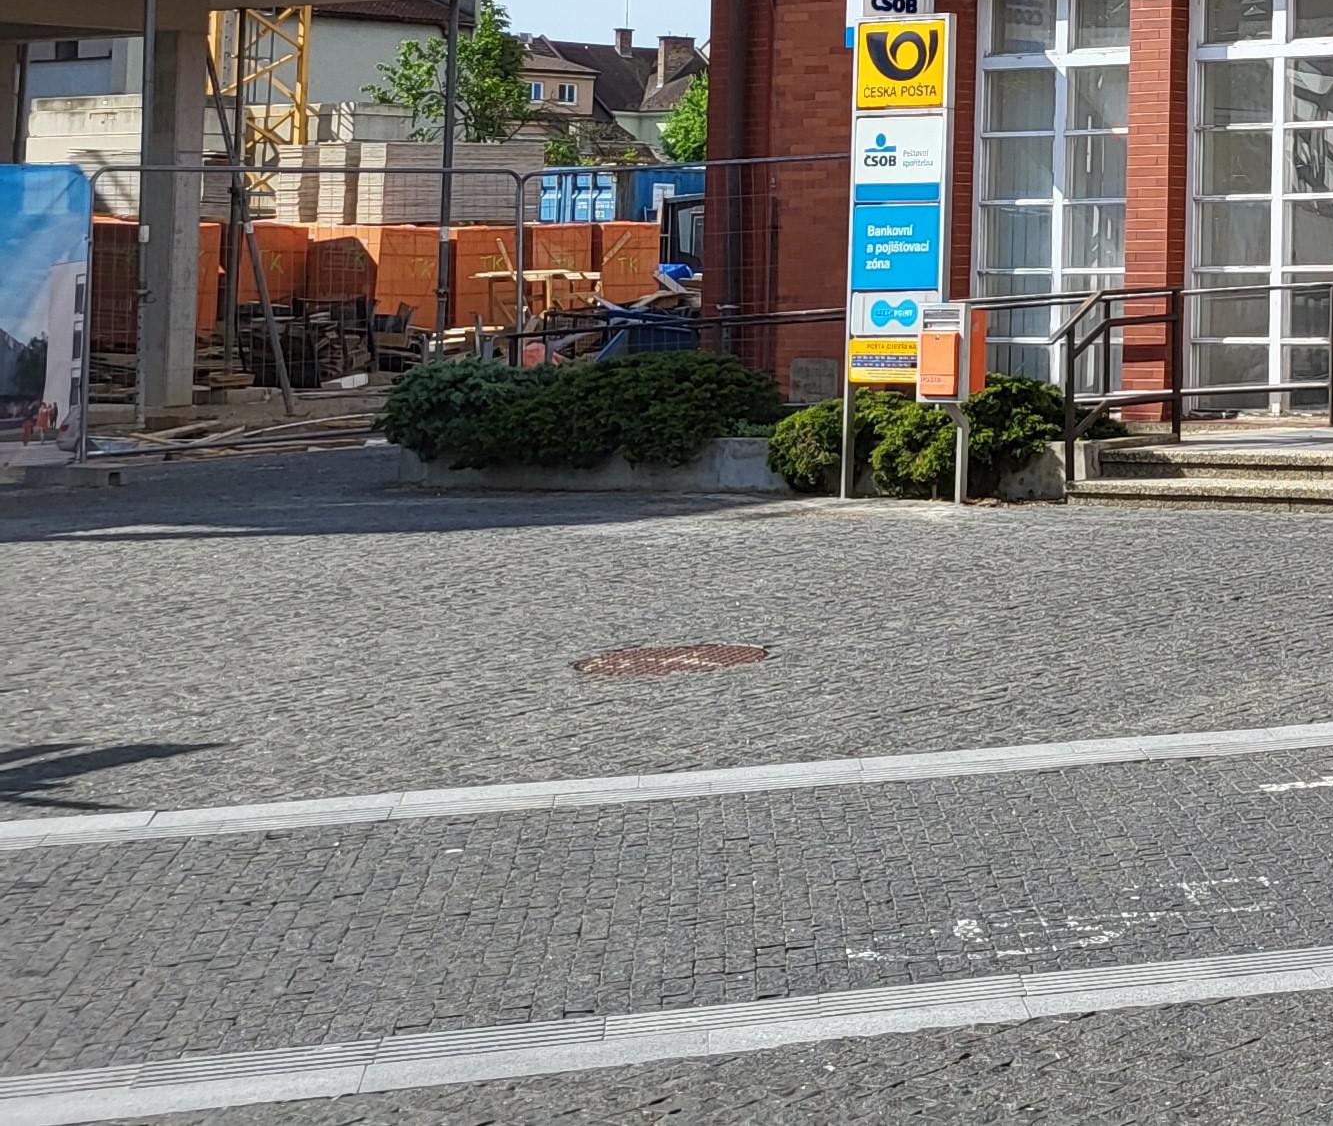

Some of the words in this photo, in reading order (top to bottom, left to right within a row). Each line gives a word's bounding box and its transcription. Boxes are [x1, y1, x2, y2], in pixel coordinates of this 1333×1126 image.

[864, 82, 897, 100] ČESKÁ
[900, 81, 937, 98] POŠTA
[864, 154, 897, 167] ČSOB
[867, 224, 913, 237] Bankovní
[866, 243, 873, 252] a
[875, 240, 930, 255] pojišťovací
[865, 258, 890, 270] zóna
